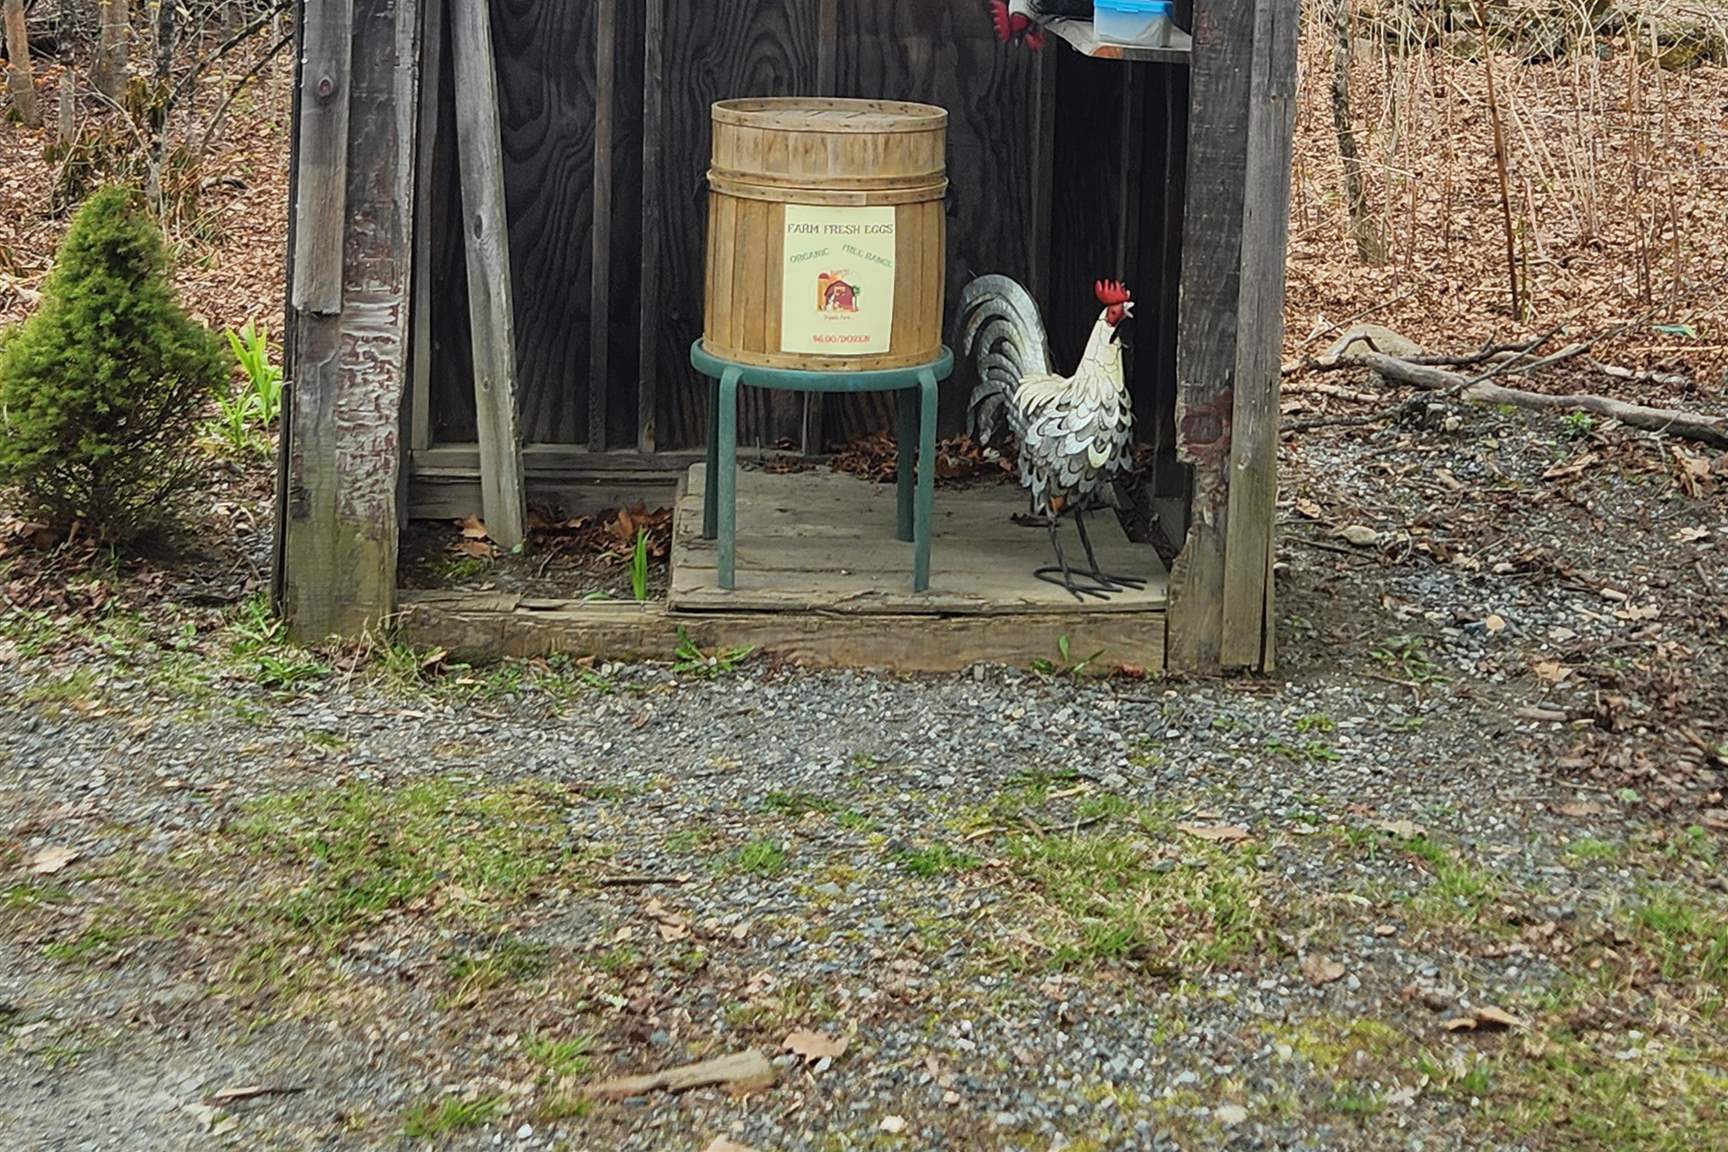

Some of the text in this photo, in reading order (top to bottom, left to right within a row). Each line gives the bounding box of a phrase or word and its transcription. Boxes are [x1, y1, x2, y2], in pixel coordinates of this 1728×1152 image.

[787, 223, 894, 235] FARM FRESH EGGS
[789, 248, 830, 263] ORGANIC
